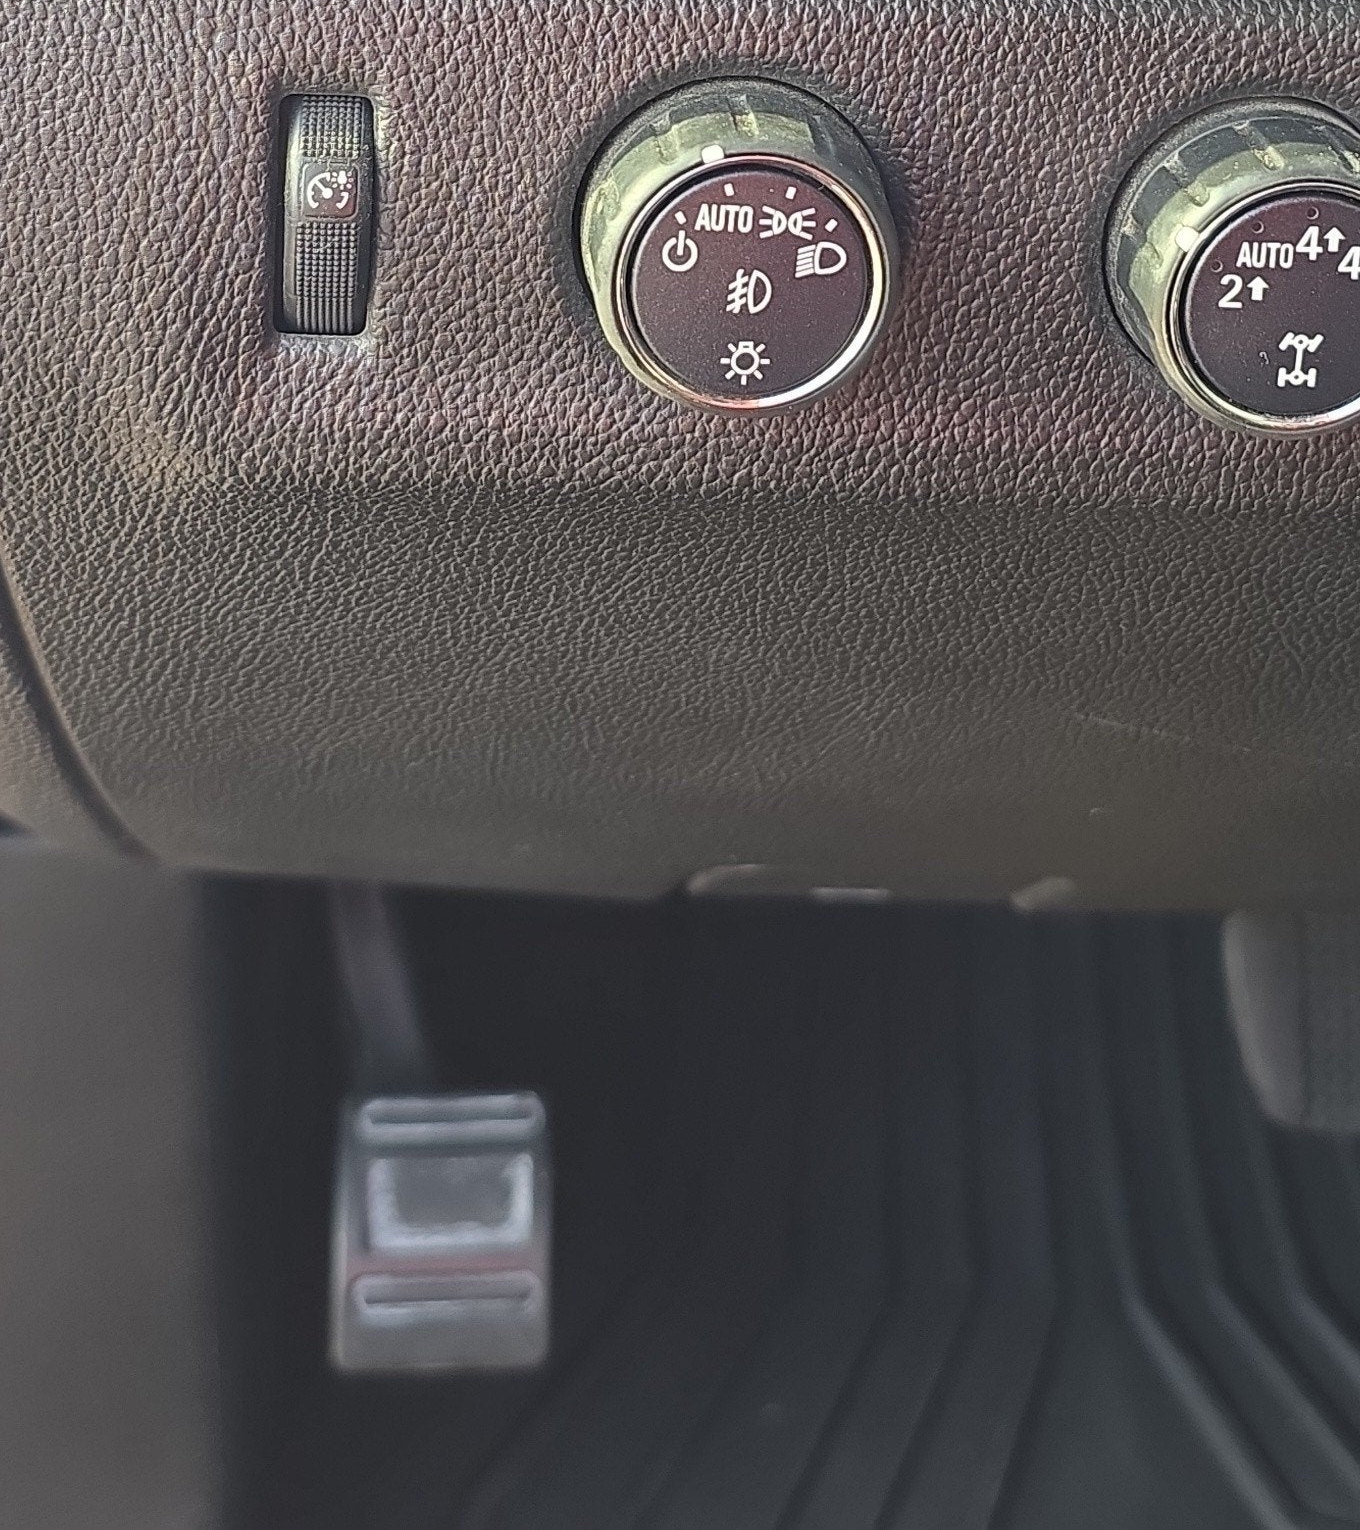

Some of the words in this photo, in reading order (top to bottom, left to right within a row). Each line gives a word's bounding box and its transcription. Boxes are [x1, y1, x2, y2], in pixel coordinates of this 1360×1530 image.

[694, 203, 754, 233] AUTO
[1236, 241, 1294, 269] AUTO
[1295, 225, 1324, 261] 4
[1218, 274, 1243, 309] 2
